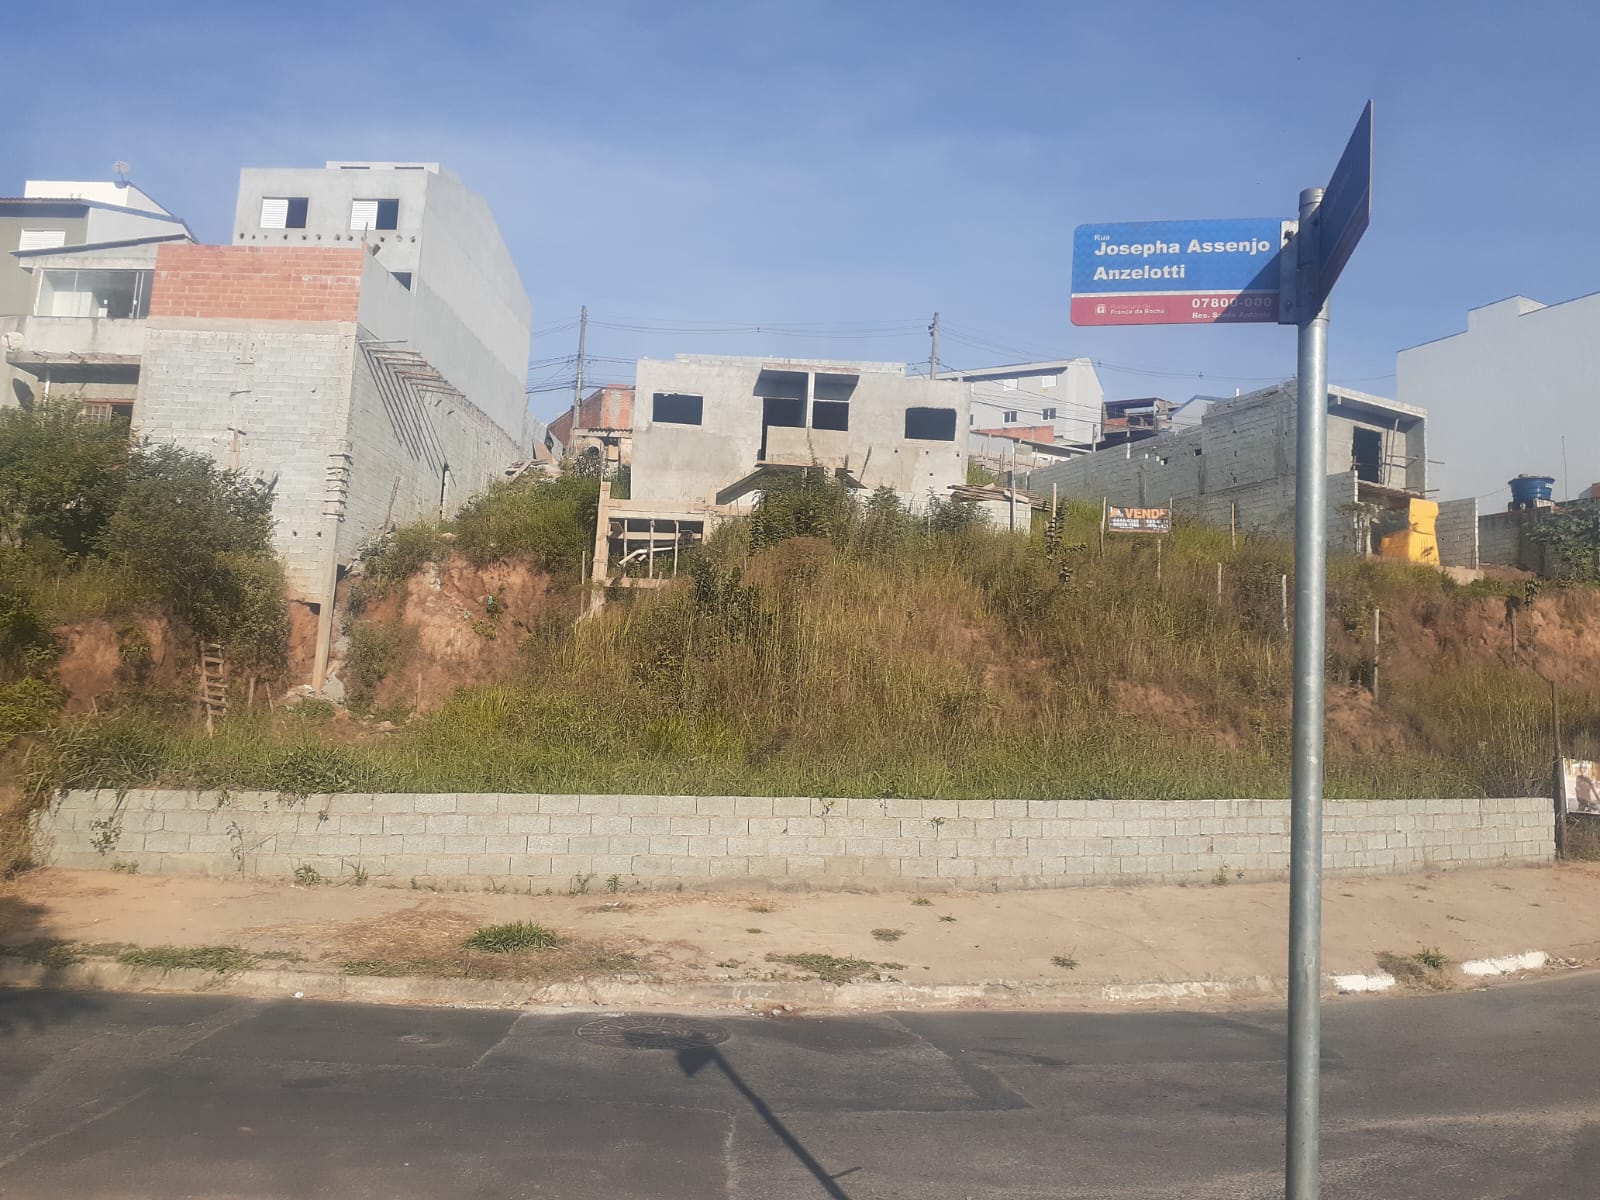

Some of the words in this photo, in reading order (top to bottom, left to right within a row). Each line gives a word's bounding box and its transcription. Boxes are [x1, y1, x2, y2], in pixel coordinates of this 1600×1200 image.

[1094, 240, 1180, 258] Josepha
[1187, 238, 1271, 255] Assenjo
[1093, 264, 1185, 281] Anzelotti
